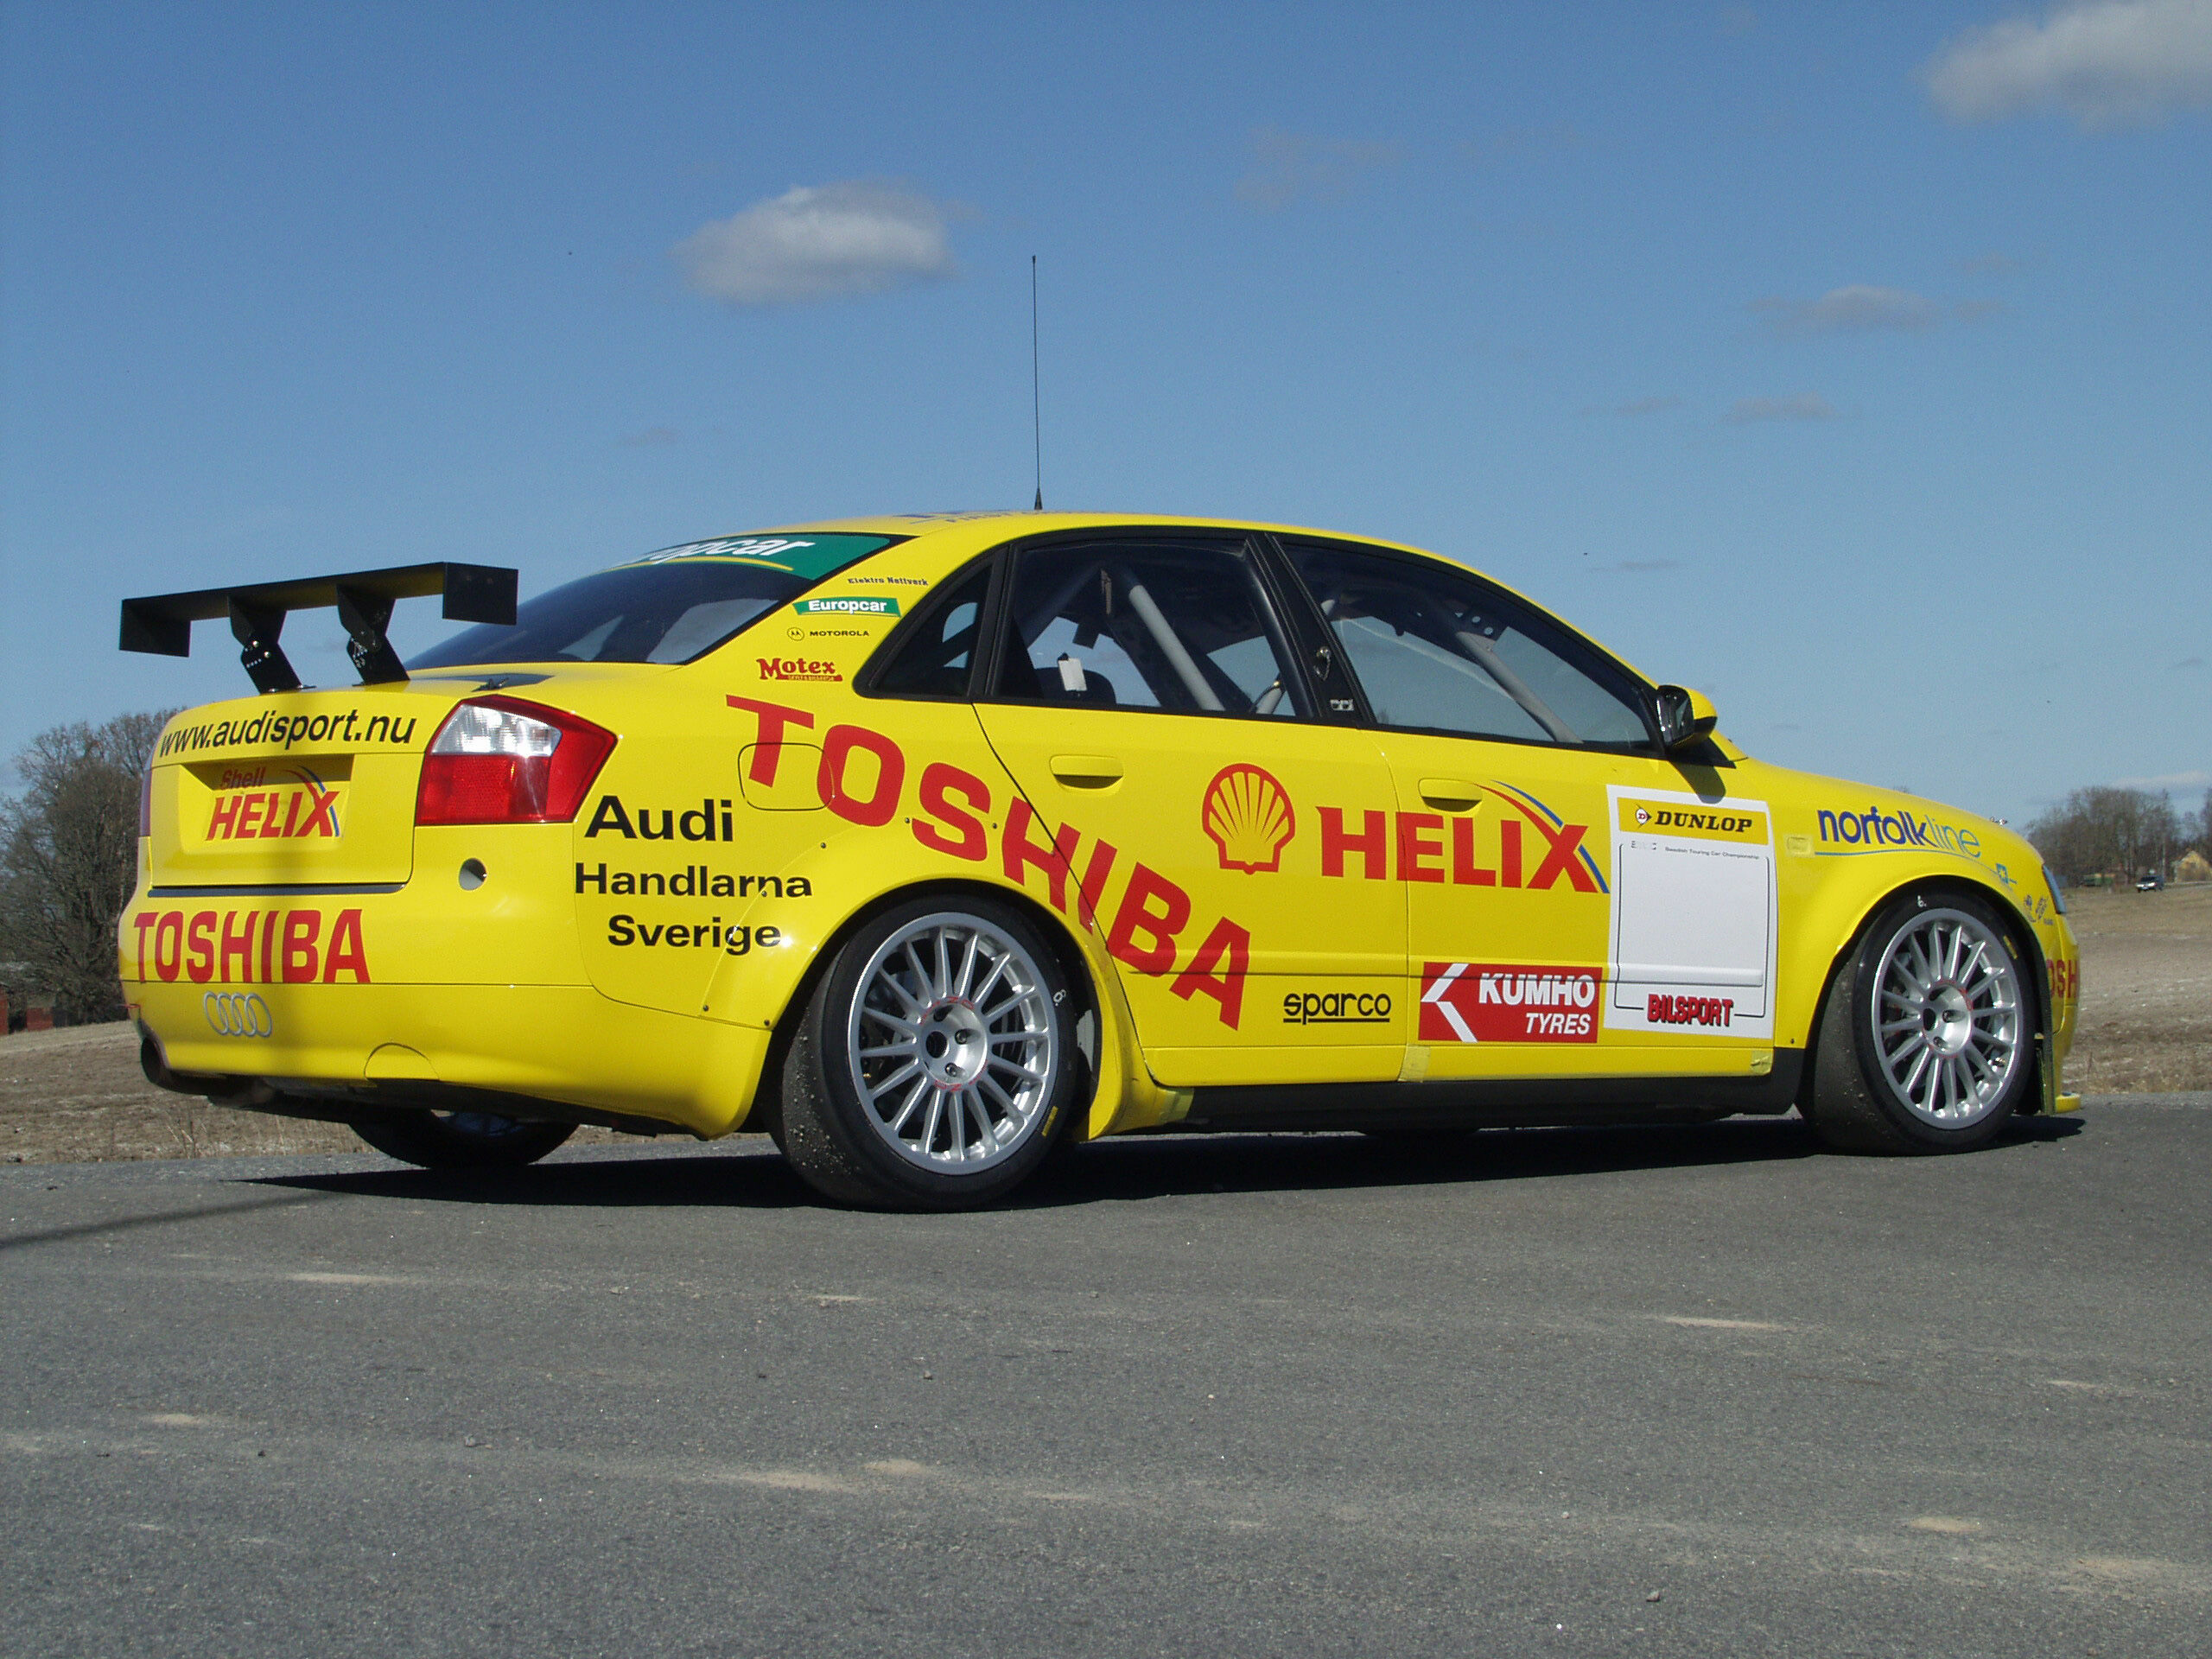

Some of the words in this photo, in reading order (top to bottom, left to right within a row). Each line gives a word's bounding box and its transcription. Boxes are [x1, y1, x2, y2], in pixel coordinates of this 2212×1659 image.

[808, 600, 887, 614] Europcar
[756, 658, 836, 680] Motex
[159, 709, 416, 758] www.audisport.nu
[220, 767, 266, 791] Shell
[207, 785, 340, 841] HELIX
[584, 794, 734, 843] Audi
[1654, 810, 1753, 833] DUNLOP
[1315, 800, 1599, 894] HELIX
[1816, 805, 1982, 859] norfolkline
[725, 694, 1251, 1030] TOSHIBA
[1688, 848, 1711, 856] Touring
[574, 861, 814, 899] Handlarna
[133, 908, 372, 984] TOSHIBA
[607, 913, 782, 956] Sverige
[1283, 992, 1391, 1025] sparco
[1478, 972, 1596, 1008] KUMHO
[1525, 1012, 1592, 1035] TYRES
[1647, 993, 1734, 1027] BILSPORT
